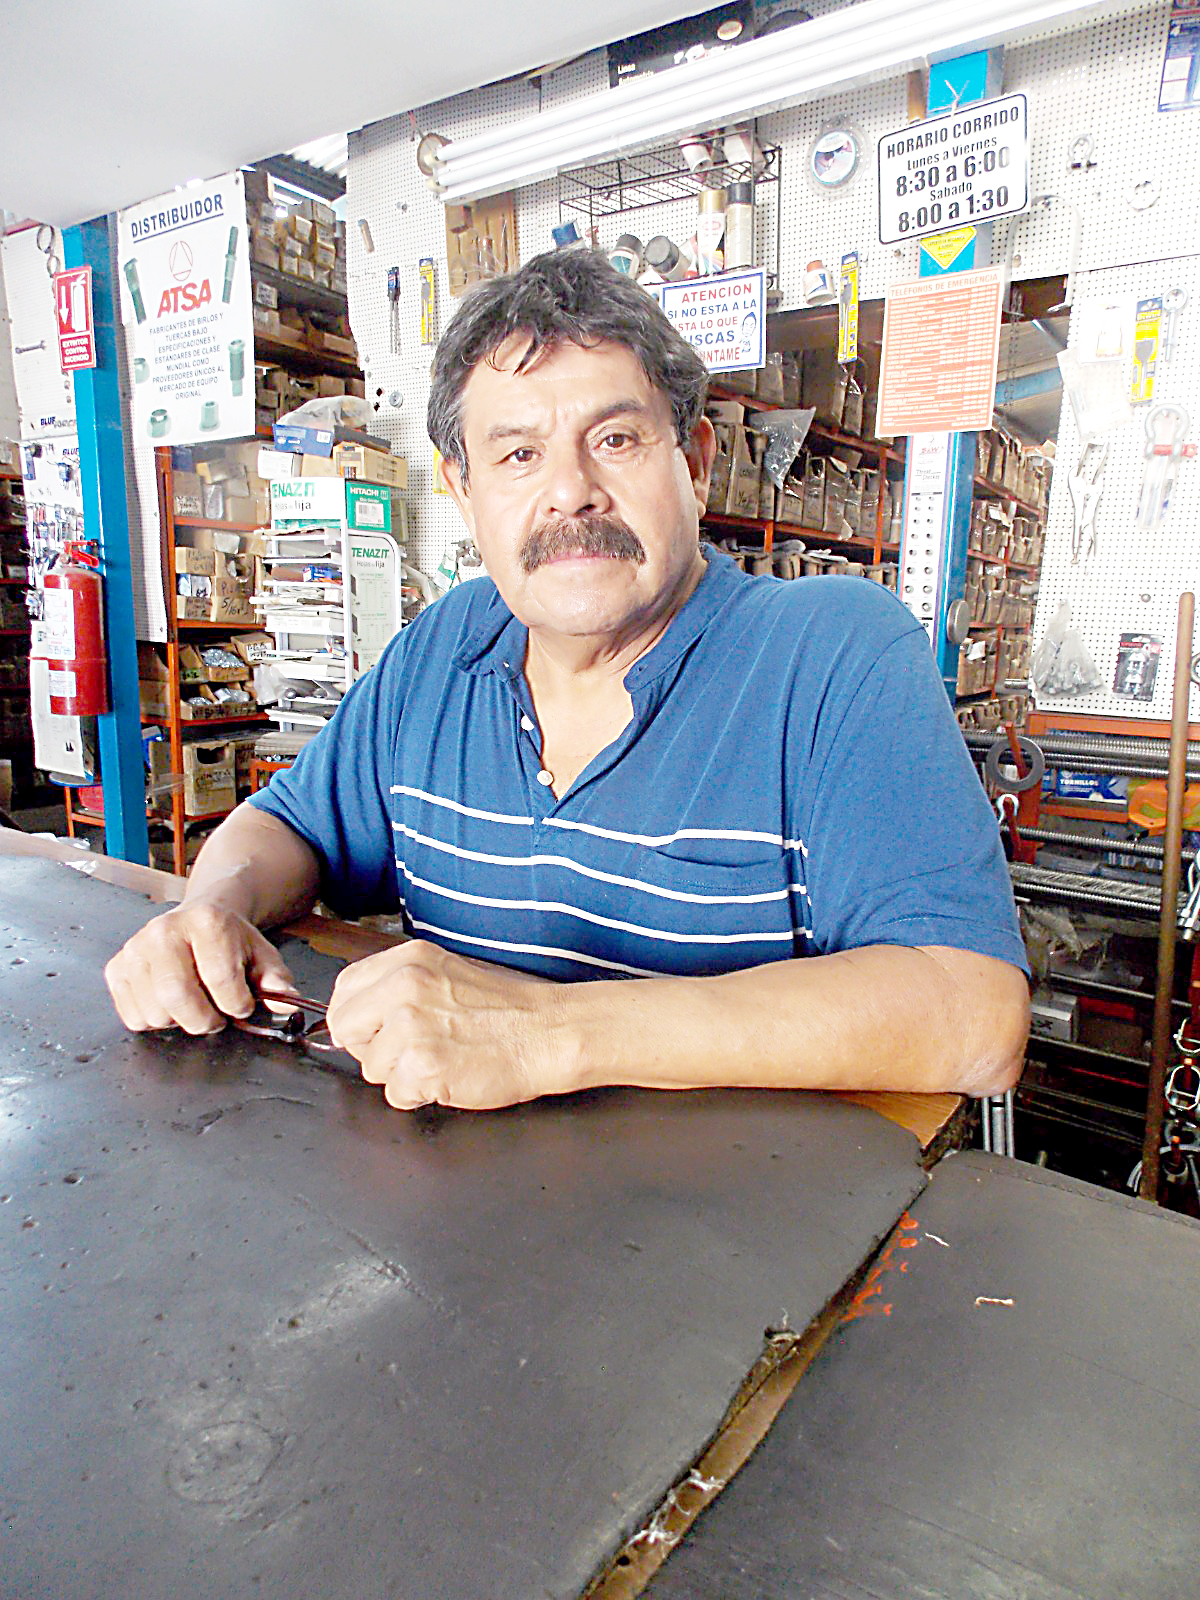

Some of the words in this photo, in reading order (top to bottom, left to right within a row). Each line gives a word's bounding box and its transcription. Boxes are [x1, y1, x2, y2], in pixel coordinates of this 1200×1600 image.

[887, 128, 948, 159] HORARIO
[953, 106, 1019, 138] CORRIDO
[907, 153, 940, 170] Lunes
[942, 150, 949, 160] a
[952, 136, 998, 157] Viernes
[896, 166, 940, 197] 8:30
[946, 165, 958, 183] a
[964, 146, 1010, 178] 6:00
[930, 182, 972, 202] Sabado
[131, 193, 224, 238] DISTRIBUIDOR
[898, 202, 942, 233] 8:00
[948, 202, 960, 220] a
[966, 185, 1009, 214] 1:30
[935, 282, 945, 291] DE
[947, 273, 998, 289] EMERGENCIA
[157, 278, 212, 318] ATSA
[682, 283, 752, 304] ATENCION
[668, 310, 678, 320] SI
[682, 308, 698, 318] NO
[701, 303, 729, 316] ESTA
[732, 302, 740, 310] A
[744, 298, 758, 310] LA
[150, 320, 187, 335] FABRICANTES
[188, 318, 196, 327] DE
[700, 319, 714, 329] LO
[716, 316, 738, 328] QUE
[166, 330, 191, 342] TUERCAS
[192, 326, 208, 336] BAJO
[158, 336, 212, 354] ESPECIFICACIONES
[193, 348, 200, 356] DE
[202, 344, 220, 354] CLASE
[166, 361, 191, 372] MUNDIAL
[192, 357, 210, 367] COMO
[152, 370, 193, 384] PROVEEDORES
[160, 382, 186, 392] MERCADO
[196, 376, 218, 386] EQUIPO
[176, 390, 202, 400] ORIGINAL
[40, 416, 56, 426] BLUE
[350, 487, 378, 496] HITACHI
[294, 500, 312, 512] lija
[351, 548, 390, 558] TENAZIT
[376, 560, 385, 568] lija
